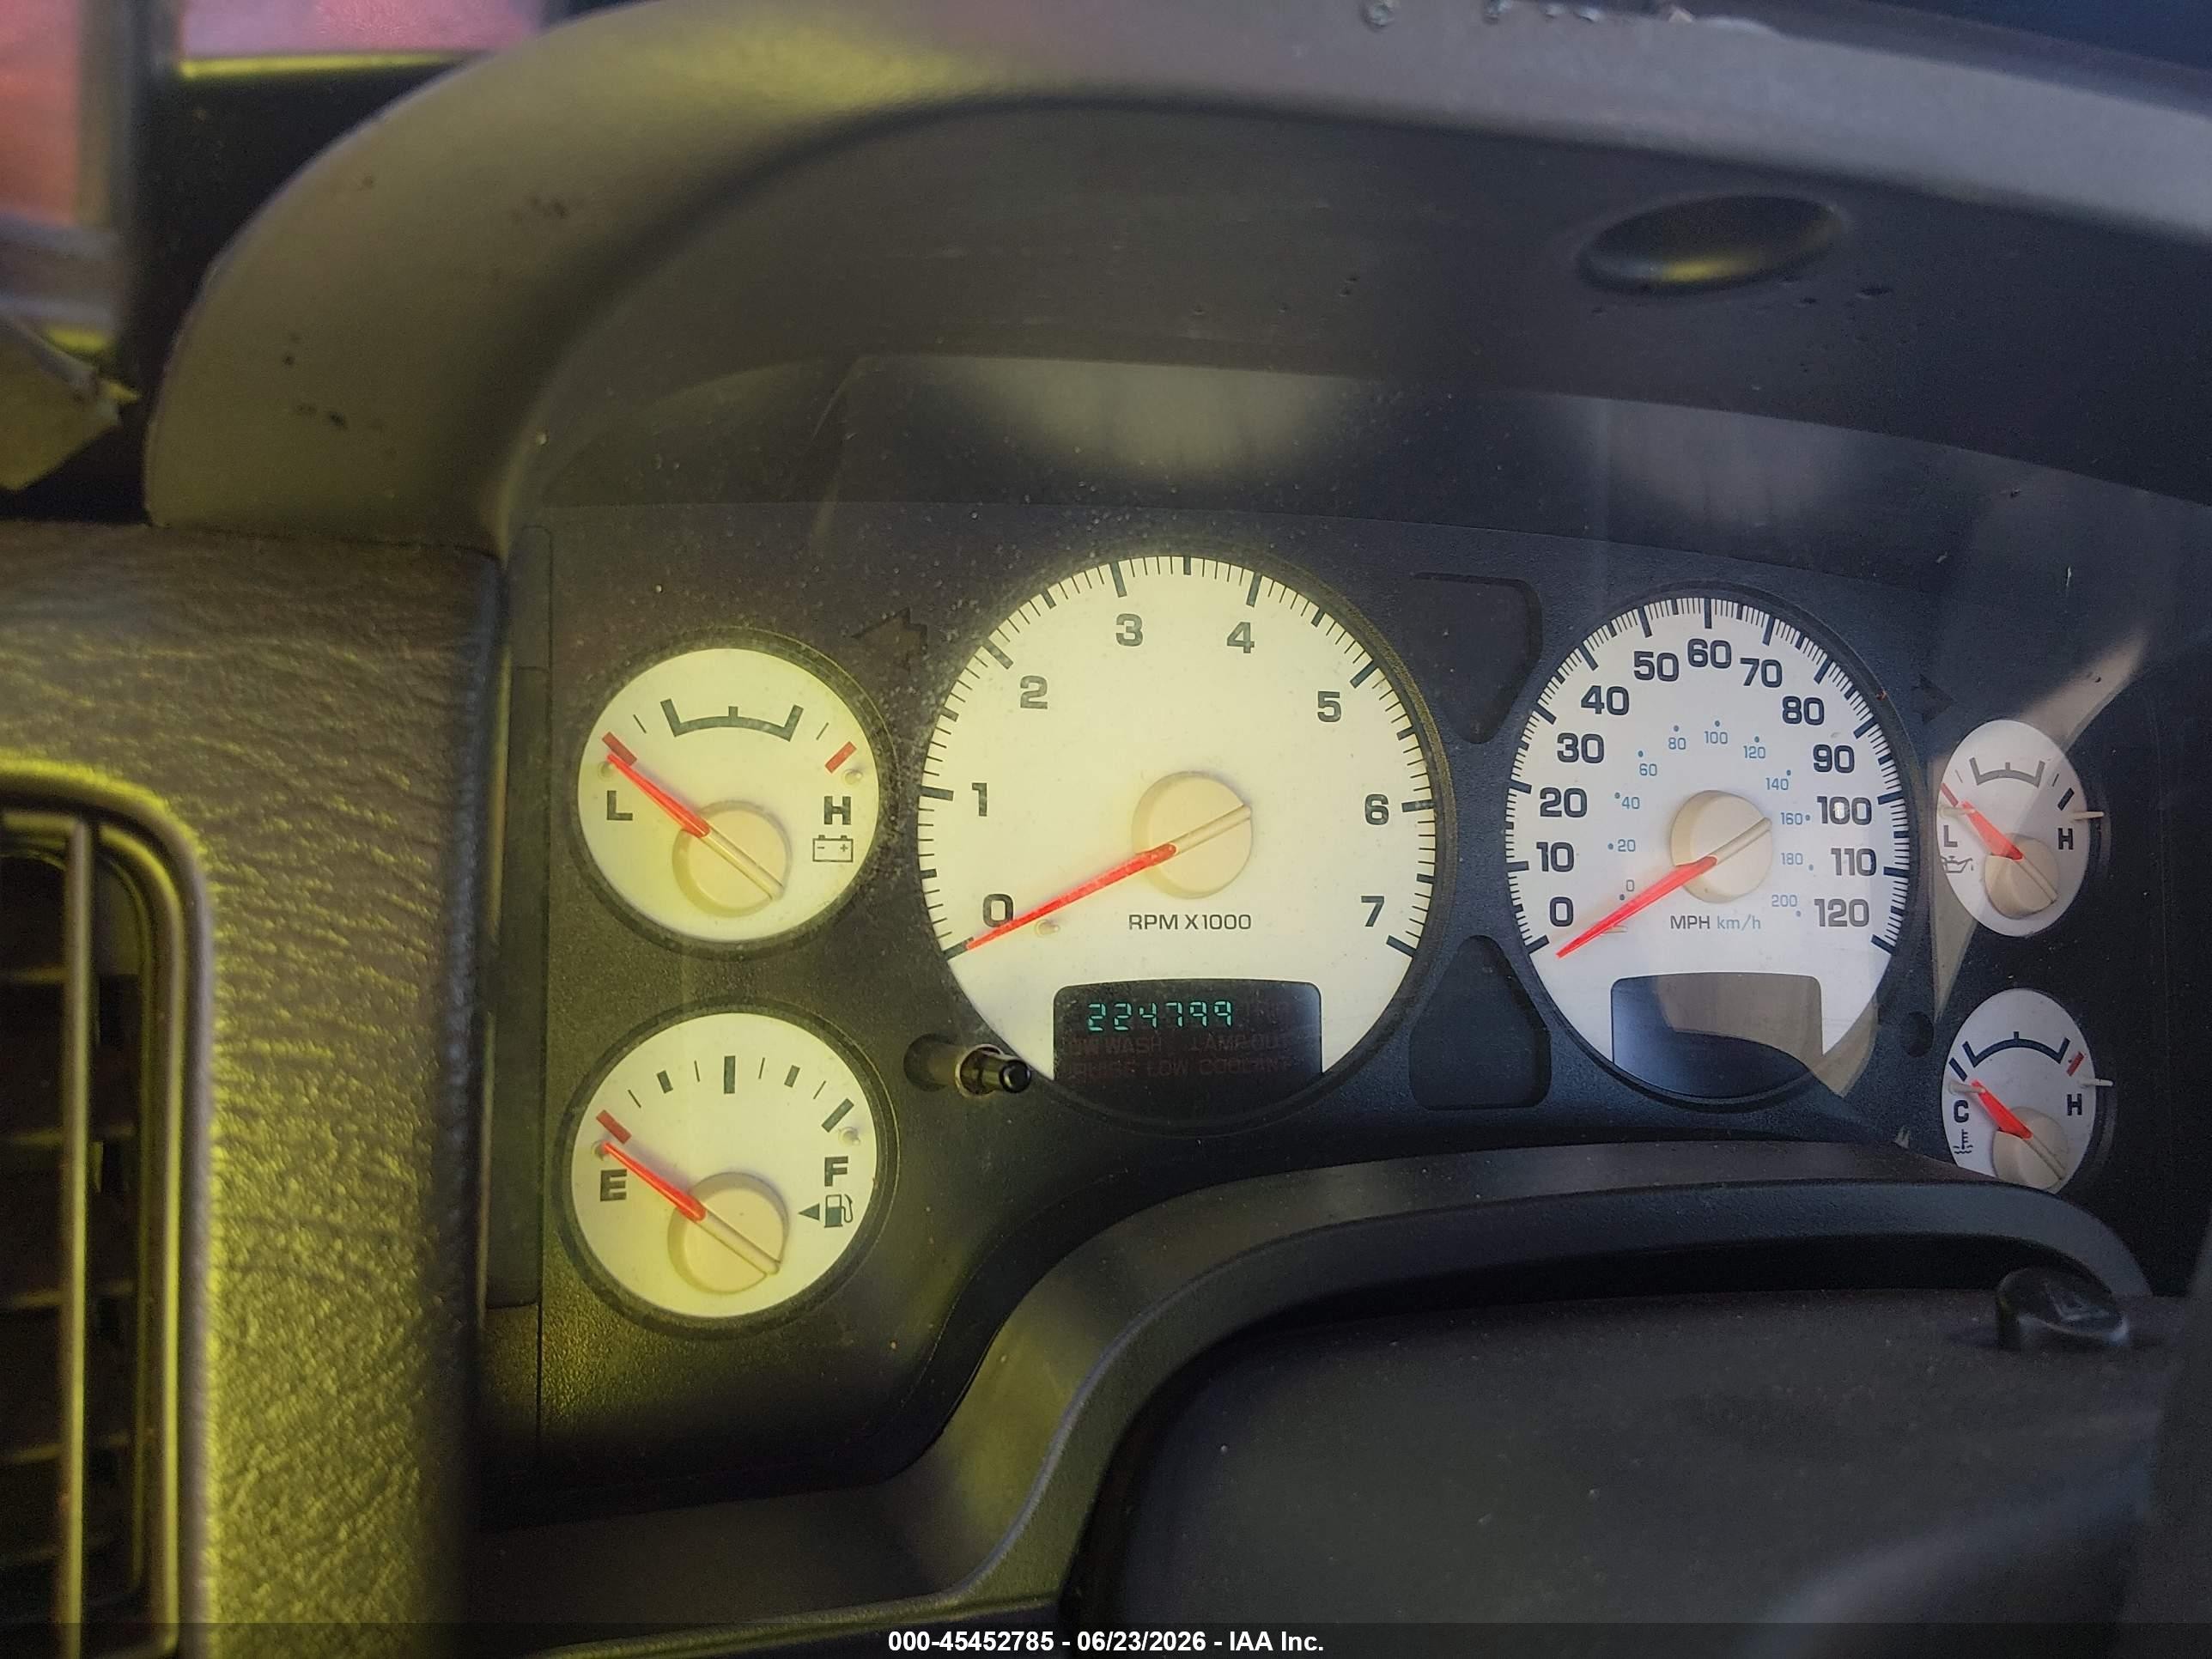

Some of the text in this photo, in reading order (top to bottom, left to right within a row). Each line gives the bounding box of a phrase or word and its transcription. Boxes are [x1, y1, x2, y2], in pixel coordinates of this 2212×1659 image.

[1116, 614, 1143, 647] 3
[1227, 622, 1255, 653] 4
[1634, 651, 1679, 682] 50
[1688, 639, 1731, 668] 60
[1741, 658, 1782, 688] 70
[1020, 676, 1048, 709] 2
[1317, 691, 1341, 722] 5
[1581, 685, 1629, 715] 40
[1783, 696, 1824, 726] 80
[1558, 733, 1604, 763] 30
[1668, 738, 1686, 750] 80
[1705, 731, 1728, 744] 100
[1743, 745, 1765, 758] 120
[1639, 763, 1657, 776] 60
[1814, 744, 1855, 773] 90
[1766, 778, 1789, 790] 140
[607, 790, 633, 821] L
[824, 796, 851, 825] H
[972, 783, 987, 817] 1
[1365, 794, 1389, 825] 6
[1540, 787, 1587, 817] 20
[1622, 797, 1639, 809] 40
[1817, 796, 1872, 825] 100
[1781, 812, 1802, 824] 160
[1618, 839, 1635, 852] 20
[1944, 825, 1958, 848] L
[2058, 828, 2073, 849] H
[1536, 842, 1574, 872] 10
[1781, 853, 1803, 865] 180
[1832, 848, 1876, 876] 110
[1626, 879, 1635, 891] 0
[982, 894, 1014, 927] 0
[1361, 896, 1384, 927] 7
[1550, 896, 1574, 927] 0
[1772, 895, 1797, 907] 200
[1814, 899, 1869, 927] 120
[1129, 915, 1177, 929] RPM
[1671, 915, 1760, 930] MPH km/h
[1089, 1001, 1231, 1030] 224799
[1954, 1100, 1969, 1122] C
[2067, 1094, 2081, 1115] H
[600, 1169, 627, 1201] E
[824, 1156, 848, 1187] F
